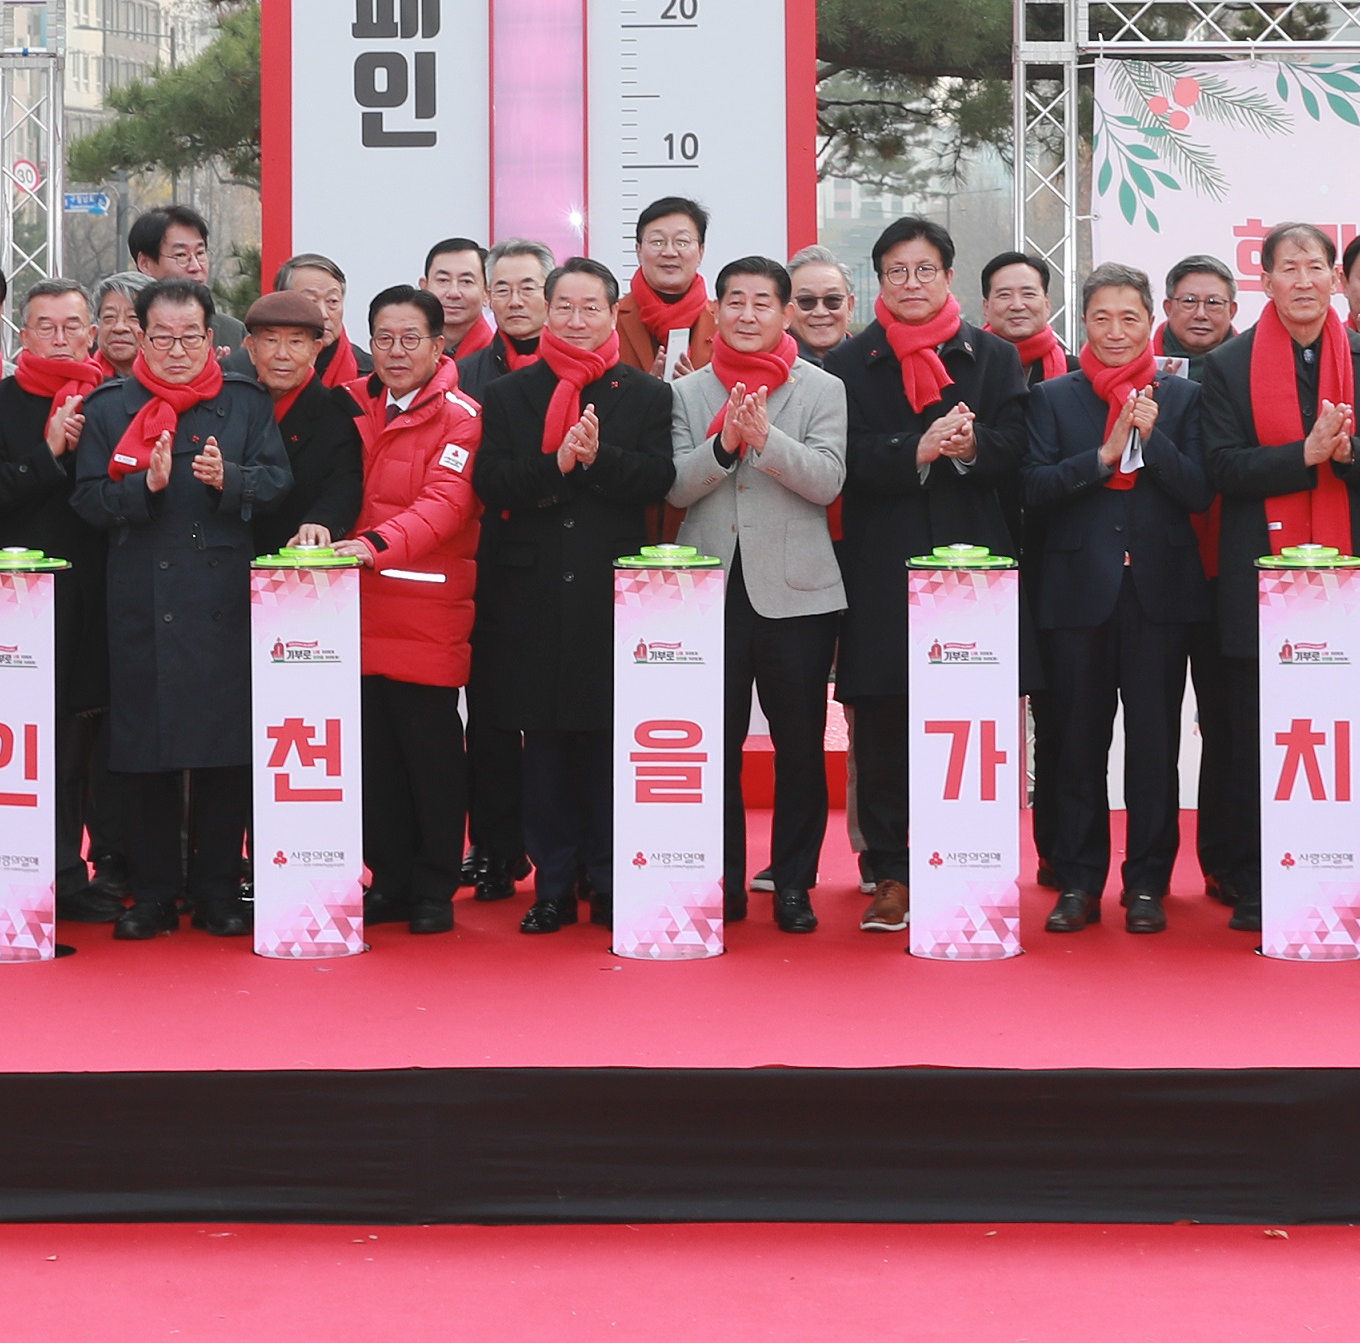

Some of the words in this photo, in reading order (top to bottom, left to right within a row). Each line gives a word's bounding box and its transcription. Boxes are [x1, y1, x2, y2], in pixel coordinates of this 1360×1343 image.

[663, 132, 699, 161] 10
[16, 168, 34, 184] 30
[286, 649, 312, 660] 기부로
[649, 650, 674, 661] 기부로
[943, 651, 970, 661] 기부로
[1295, 651, 1321, 661] 기부로
[267, 717, 343, 803] 천
[630, 720, 708, 803] 을
[925, 720, 1007, 801] 가
[1274, 719, 1351, 802] 치
[290, 850, 345, 863] 사랑의열매
[650, 852, 706, 864] 사랑의열매
[946, 852, 1002, 864] 사랑의열매
[1299, 852, 1354, 865] 사랑의열매
